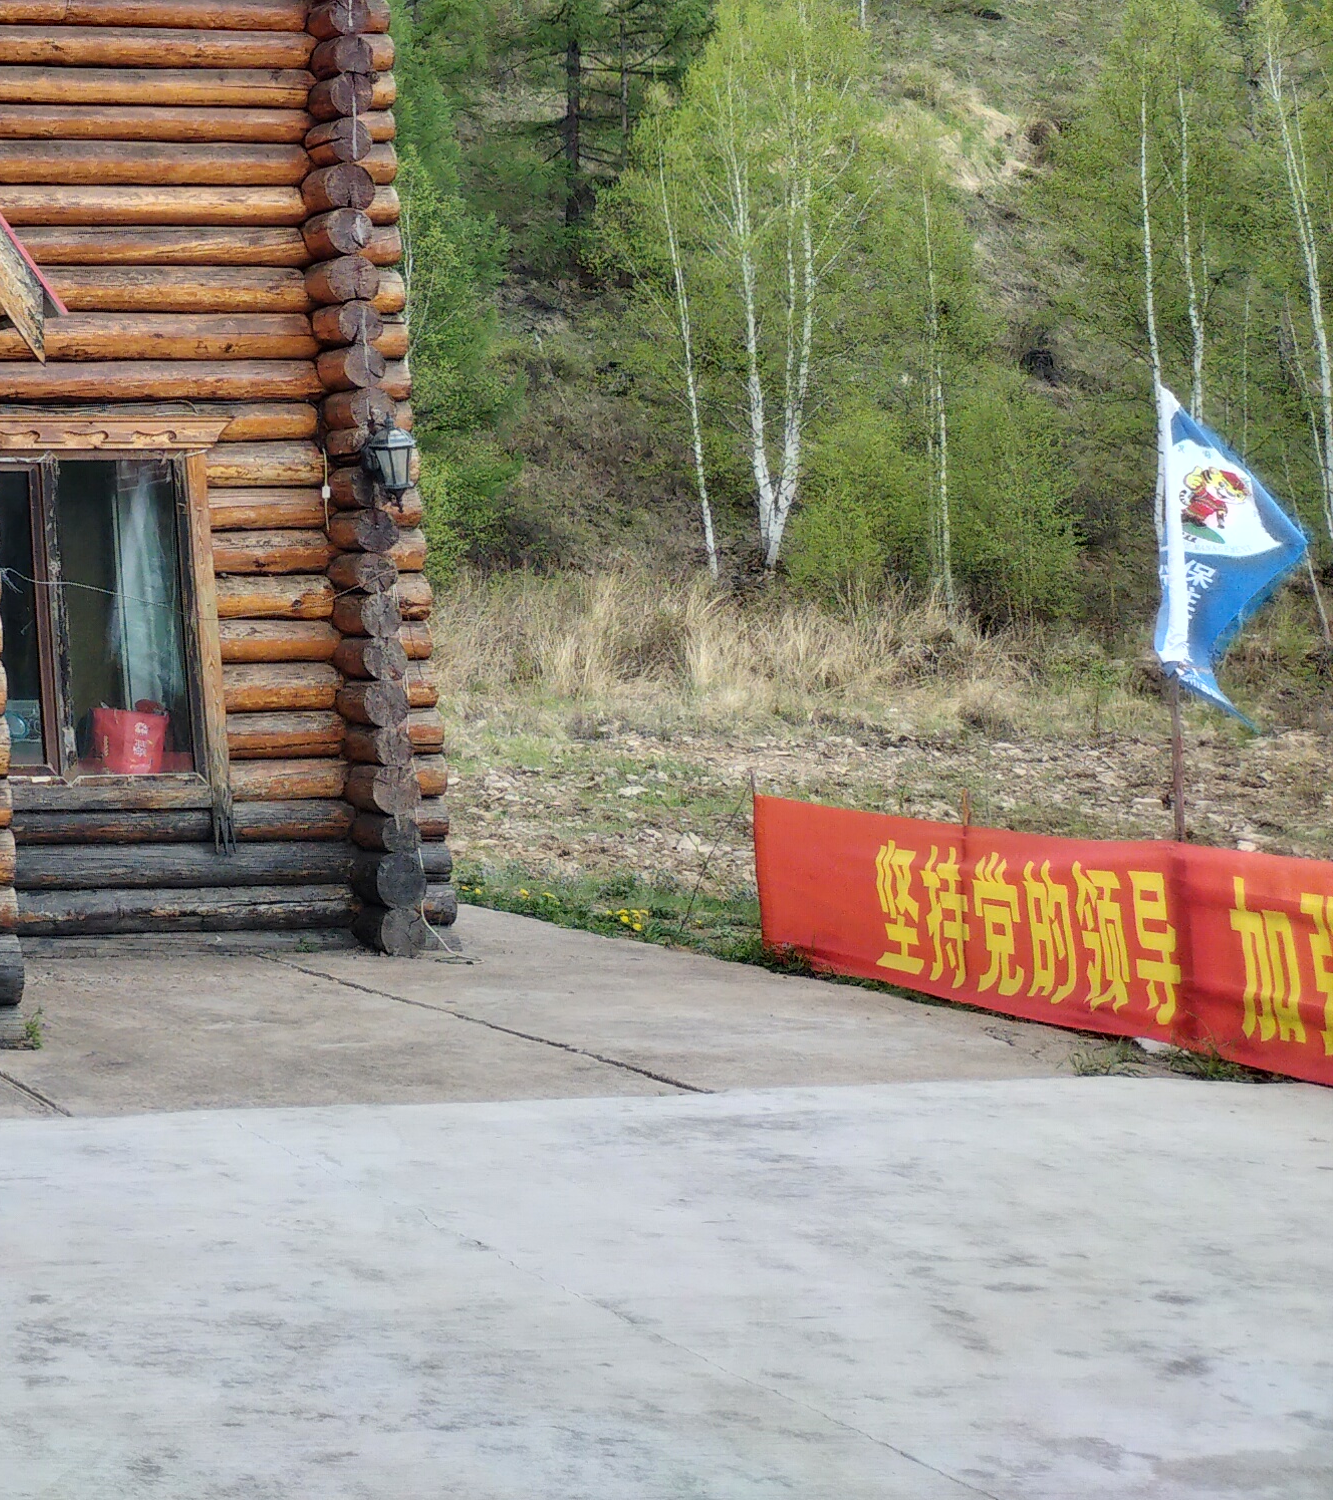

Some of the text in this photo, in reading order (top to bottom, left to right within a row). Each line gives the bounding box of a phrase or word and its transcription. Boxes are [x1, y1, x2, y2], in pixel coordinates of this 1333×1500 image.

[875, 838, 1183, 1026] 坚持党的领导
